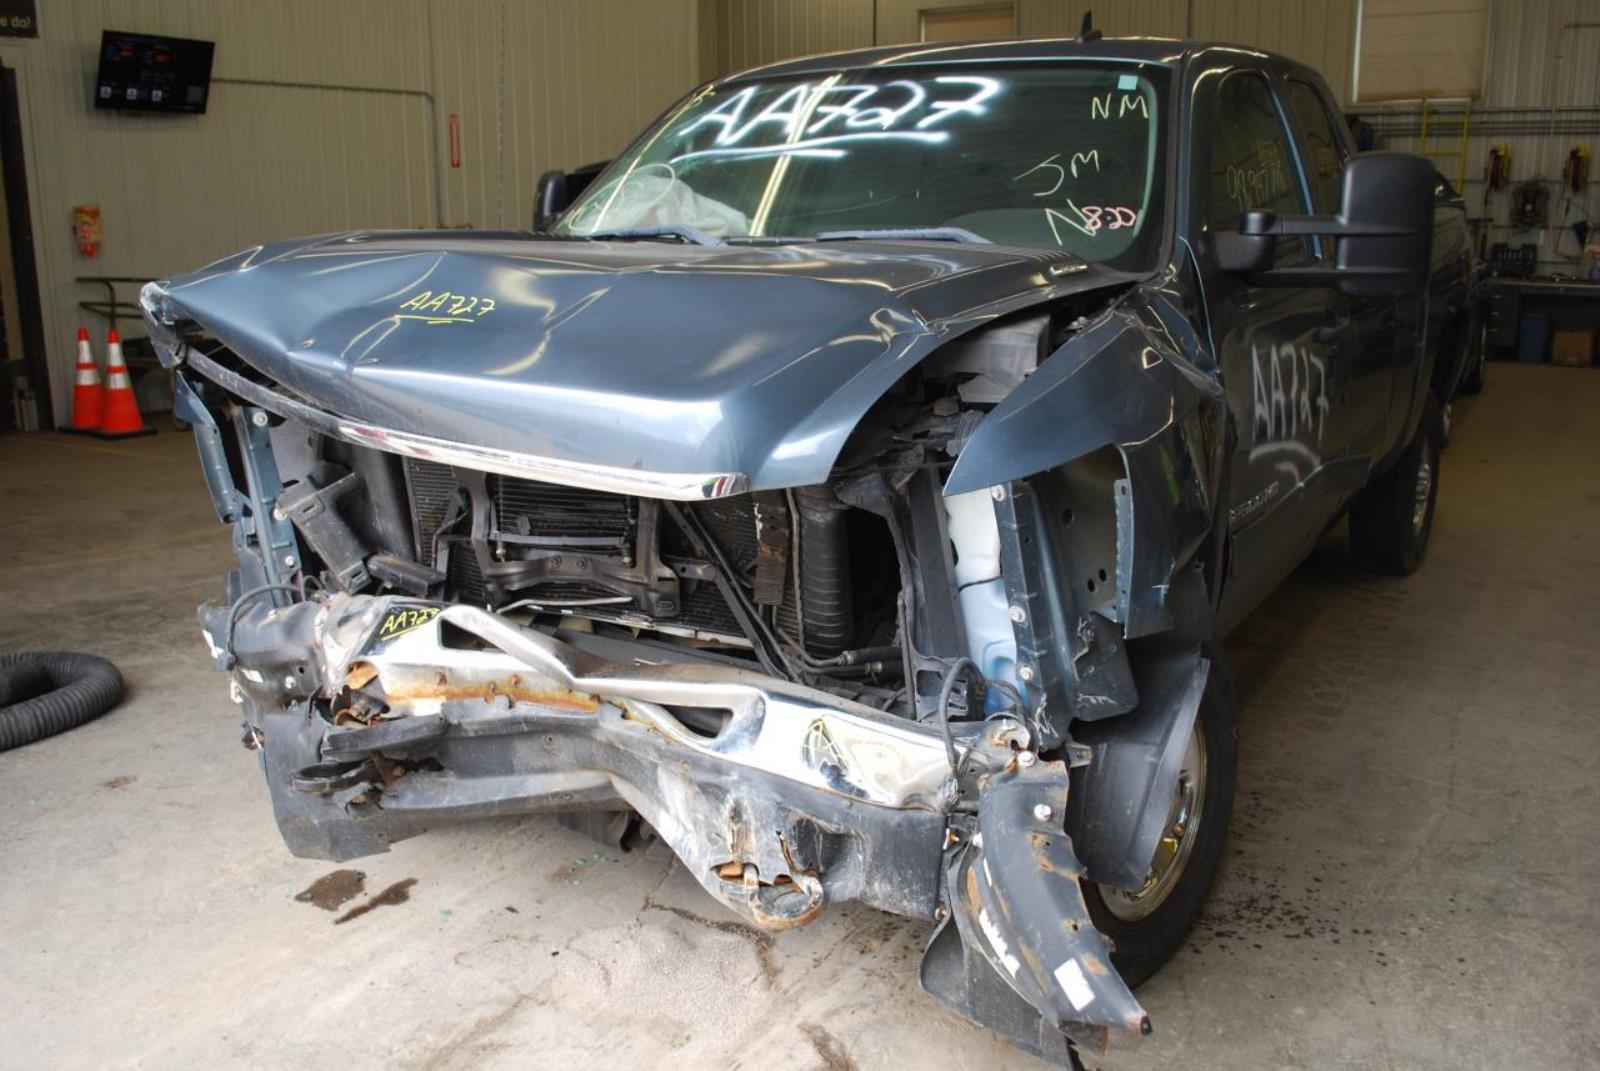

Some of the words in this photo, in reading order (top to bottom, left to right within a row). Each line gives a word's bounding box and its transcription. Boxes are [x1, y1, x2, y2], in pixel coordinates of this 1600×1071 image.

[11, 15, 31, 29] do!
[678, 76, 1004, 146] AA727
[400, 290, 495, 316] AA727
[380, 607, 440, 634] AA727
